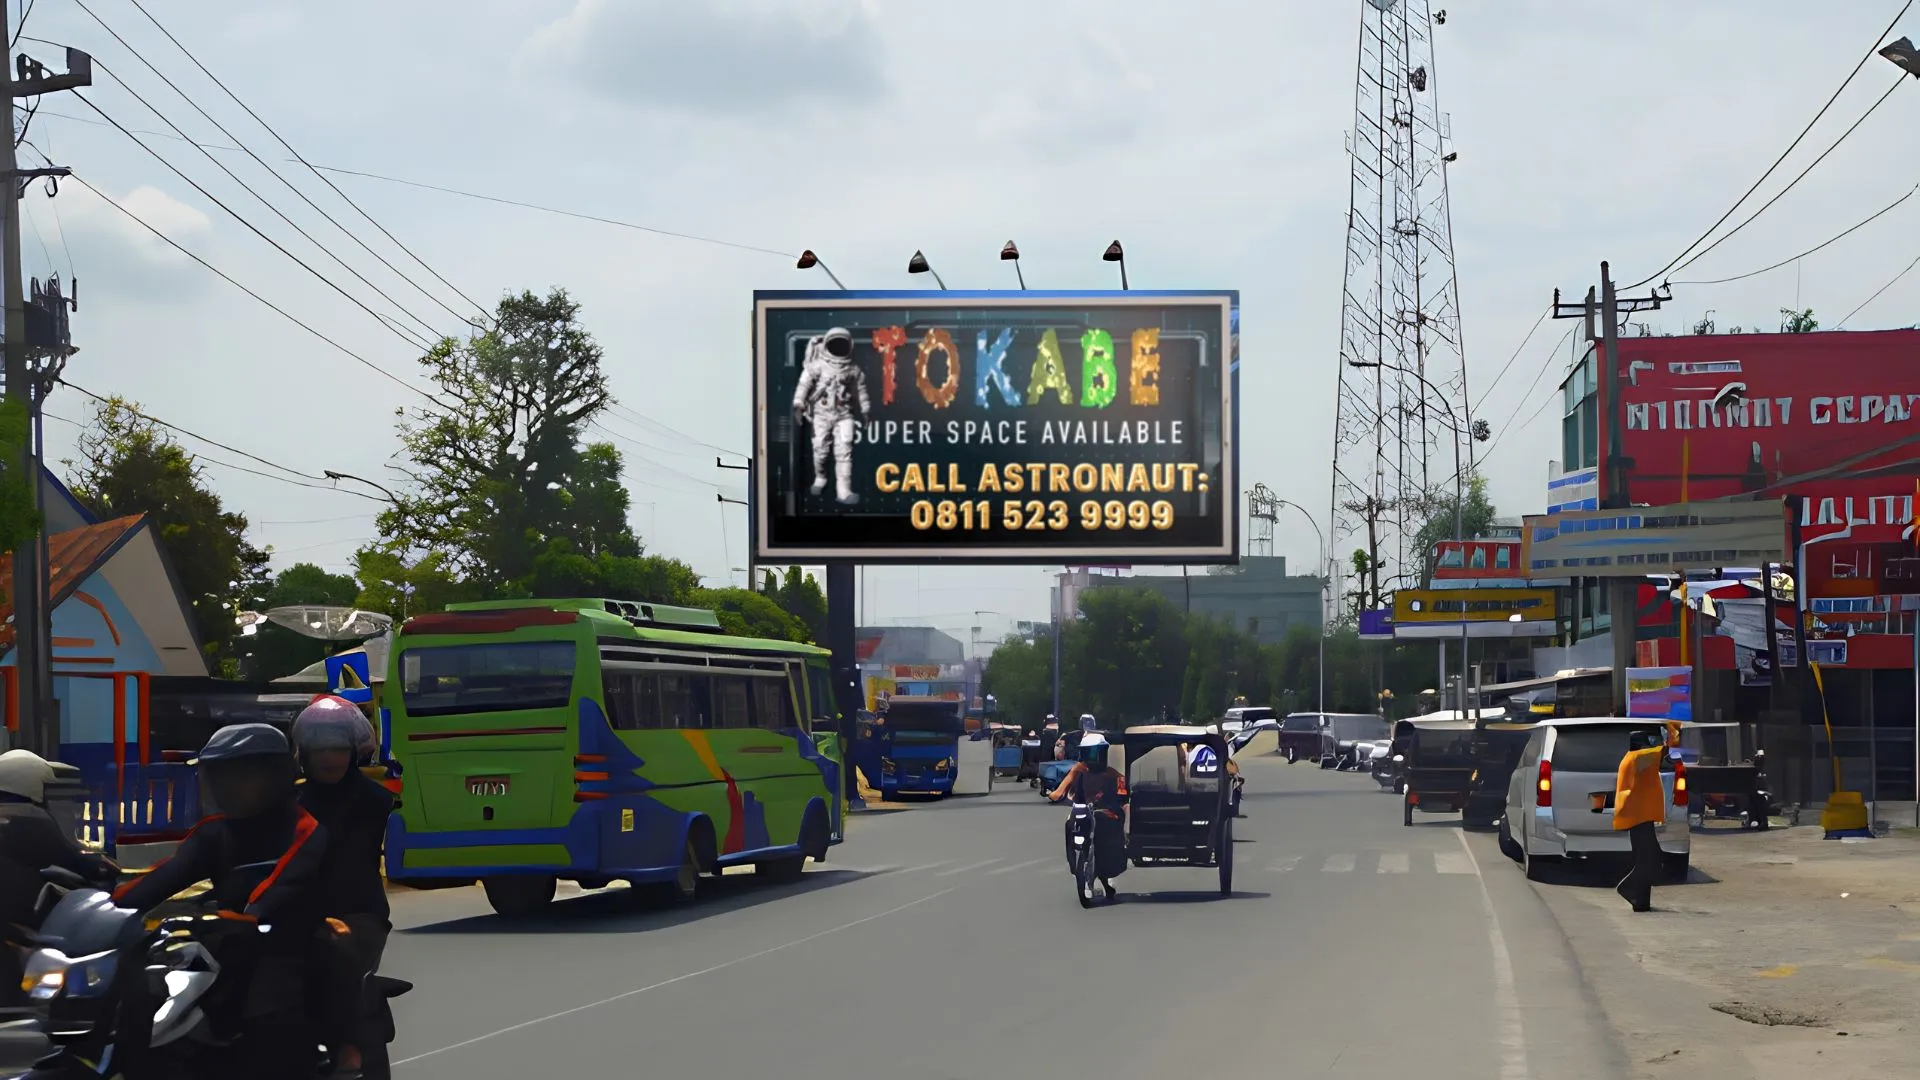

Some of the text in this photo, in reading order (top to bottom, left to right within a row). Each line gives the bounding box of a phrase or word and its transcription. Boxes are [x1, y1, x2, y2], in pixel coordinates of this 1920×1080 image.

[872, 325, 1161, 409] TOKABE
[853, 420, 1183, 444] SUPER SPACE AVAILABLE
[875, 463, 1209, 493] CALL ASTRONAUT:
[911, 500, 1174, 530] 0811 523 9999
